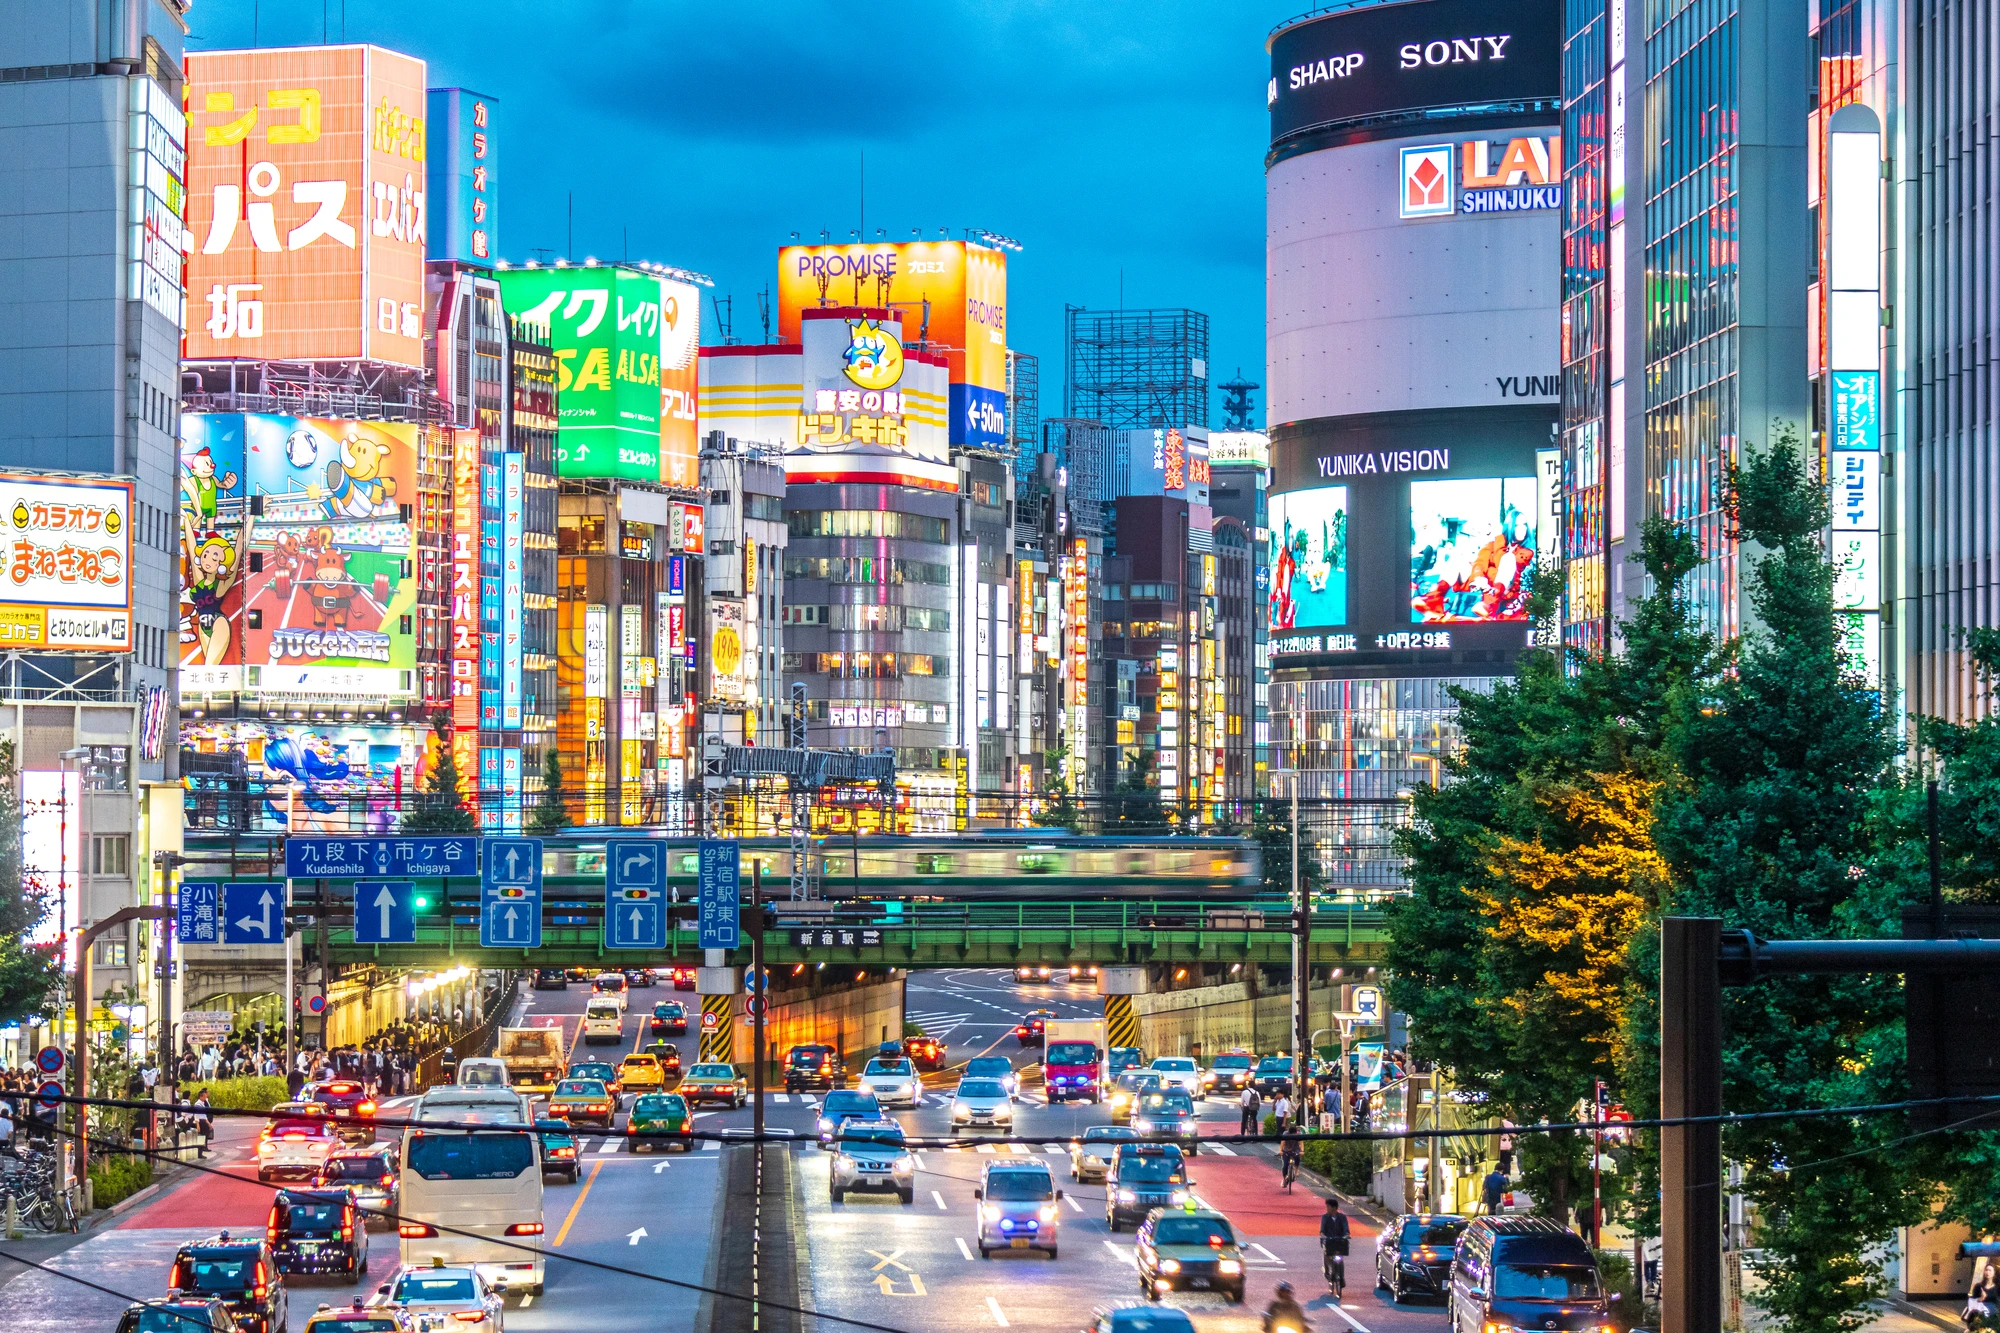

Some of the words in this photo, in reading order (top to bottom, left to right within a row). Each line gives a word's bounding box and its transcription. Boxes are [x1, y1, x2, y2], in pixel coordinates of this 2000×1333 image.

[1400, 34, 1510, 69] SONY
[1290, 53, 1364, 90] SHARP
[182, 84, 321, 147] ンコ
[473, 101, 489, 259] カラオケ館
[1462, 136, 1560, 188] LA
[182, 161, 356, 255] パス
[373, 173, 425, 245] エスパス
[1462, 187, 1561, 214] SHINJUKU
[798, 253, 897, 277] PROMISE
[907, 260, 945, 274] プロミス
[181, 284, 264, 338] 拓
[378, 297, 419, 339] 日拓
[511, 289, 609, 345] イク
[617, 295, 658, 337] レイク
[968, 298, 1003, 329] PROMISE
[616, 348, 658, 387] ALSA
[661, 387, 696, 421] アコム
[980, 403, 1004, 435] 50m
[1850, 375, 1867, 446] オアシス
[1164, 427, 1185, 490] 東海苑
[1318, 453, 1377, 478] YUNIKA
[1380, 449, 1449, 472] VISION
[32, 504, 102, 530] カラオケ
[672, 509, 680, 545] 戸谷ビル
[11, 538, 121, 583] まねきねこ
[50, 618, 101, 638] となりのビル
[112, 620, 125, 638] 4F
[271, 627, 391, 663] JUGGLER
[672, 616, 681, 647] アイフル
[588, 620, 599, 684] 小松ビル
[301, 842, 370, 862] 九段下
[306, 863, 365, 875] Kudanshita
[378, 853, 386, 863] 4
[407, 863, 450, 875] Ichigaya
[703, 848, 716, 898] Shinjuku
[181, 886, 192, 914] Otaki
[716, 845, 734, 942] 新宿駅東口
[181, 916, 191, 940] Brdg.
[194, 886, 214, 940] 小滝橋
[703, 901, 716, 940] Sta.-E.
[801, 933, 854, 945] 新宿駅
